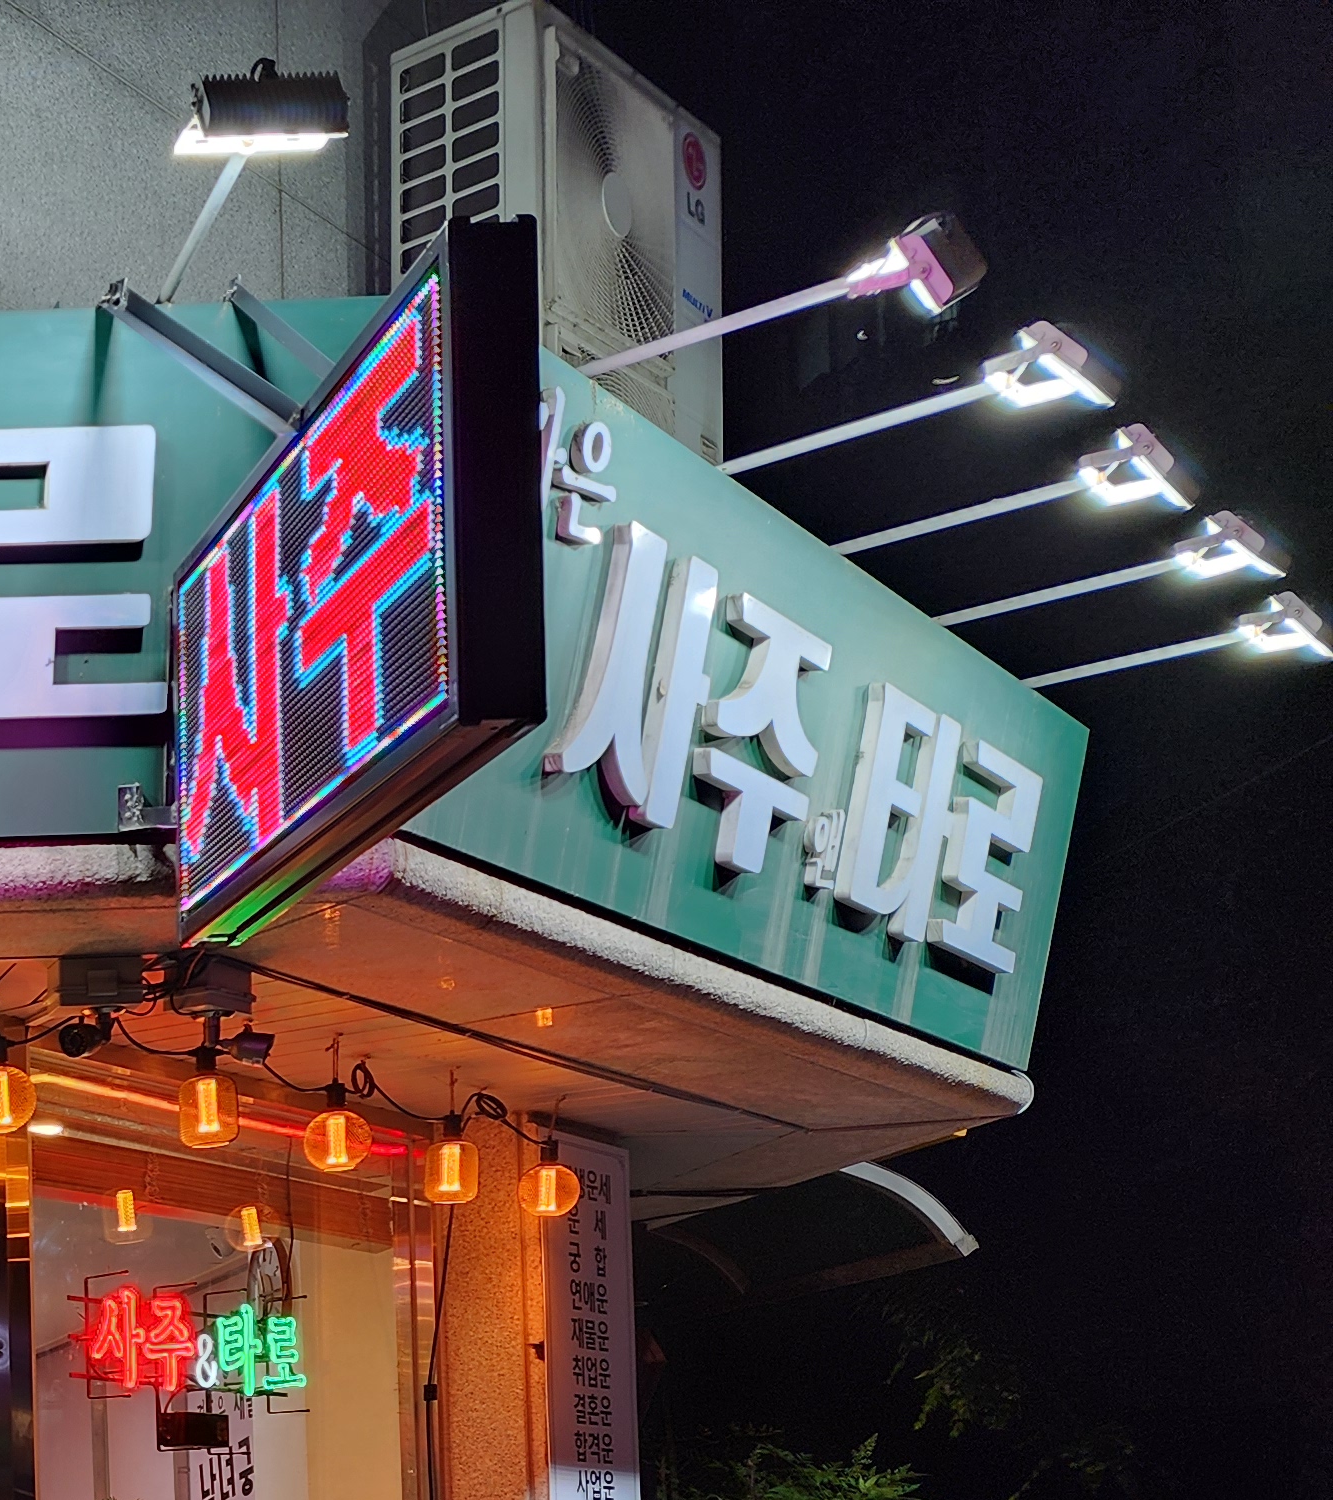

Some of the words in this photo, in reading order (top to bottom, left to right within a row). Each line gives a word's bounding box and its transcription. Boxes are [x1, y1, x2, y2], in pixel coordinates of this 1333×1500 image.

[687, 191, 706, 226] LG
[183, 312, 434, 860] 사주
[542, 518, 833, 876] 사주
[804, 808, 847, 890] 앤
[833, 681, 1044, 975] 타로
[568, 1241, 608, 1278] 궁합
[569, 1280, 609, 1315] 연애운
[571, 1318, 610, 1352] 재물운
[572, 1355, 611, 1390] 취업운
[573, 1393, 613, 1427] 결혼운
[574, 1430, 614, 1464] 합격운
